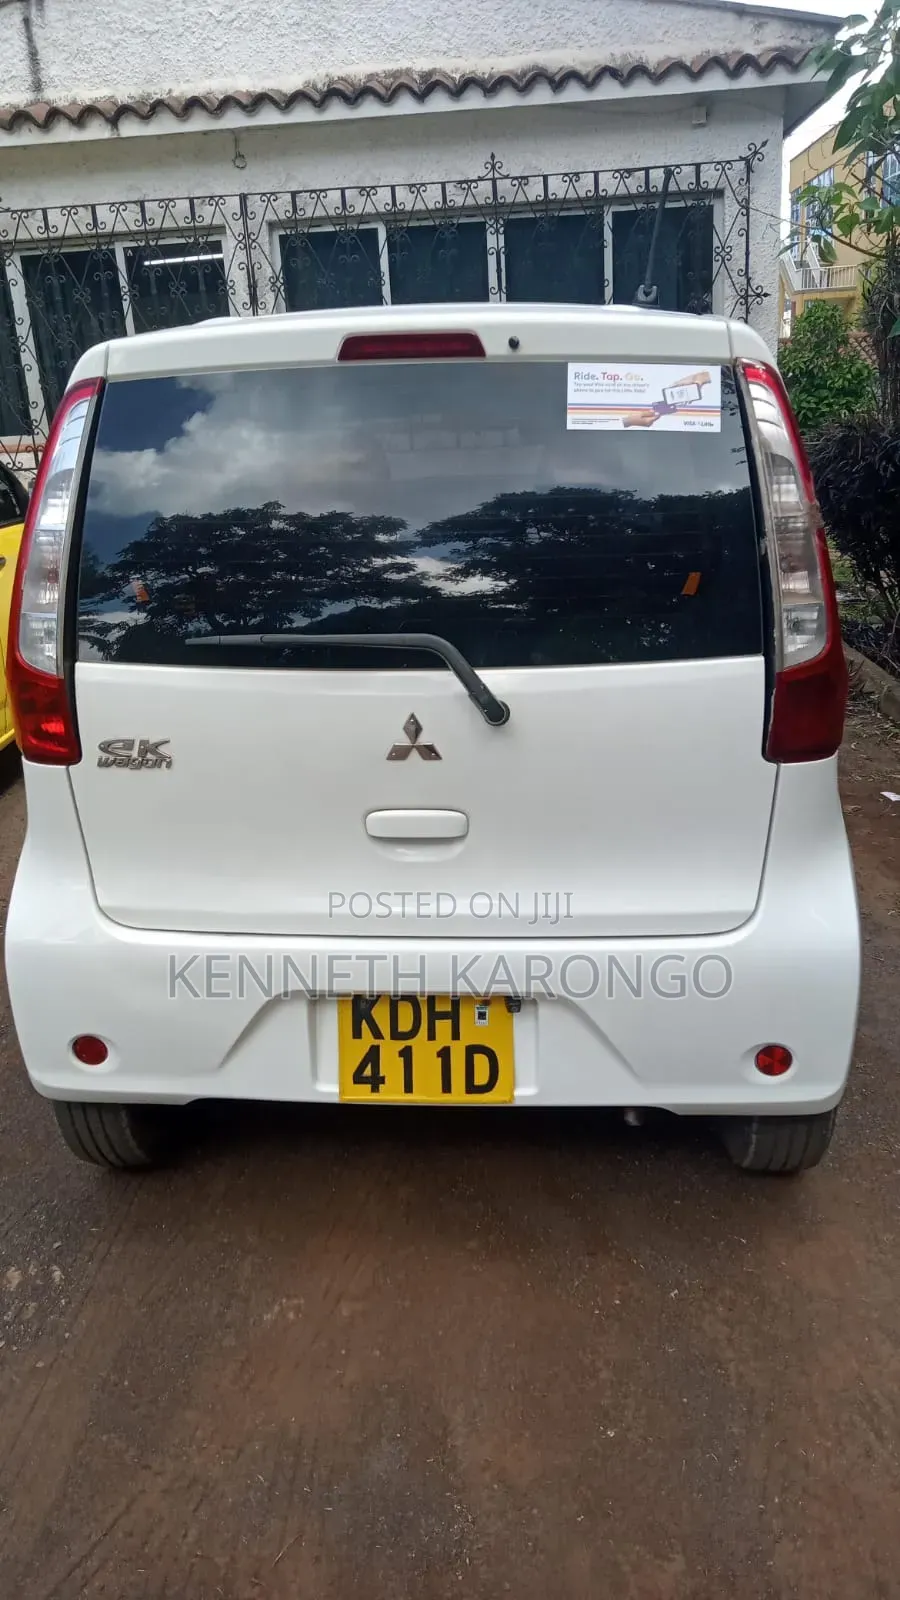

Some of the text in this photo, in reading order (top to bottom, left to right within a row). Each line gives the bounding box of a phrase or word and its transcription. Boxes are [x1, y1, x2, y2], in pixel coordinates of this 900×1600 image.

[574, 371, 644, 384] Ride. Tap. Go.
[97, 756, 173, 770] wagon
[351, 994, 461, 1041] KDH
[352, 1044, 499, 1094] 411D
